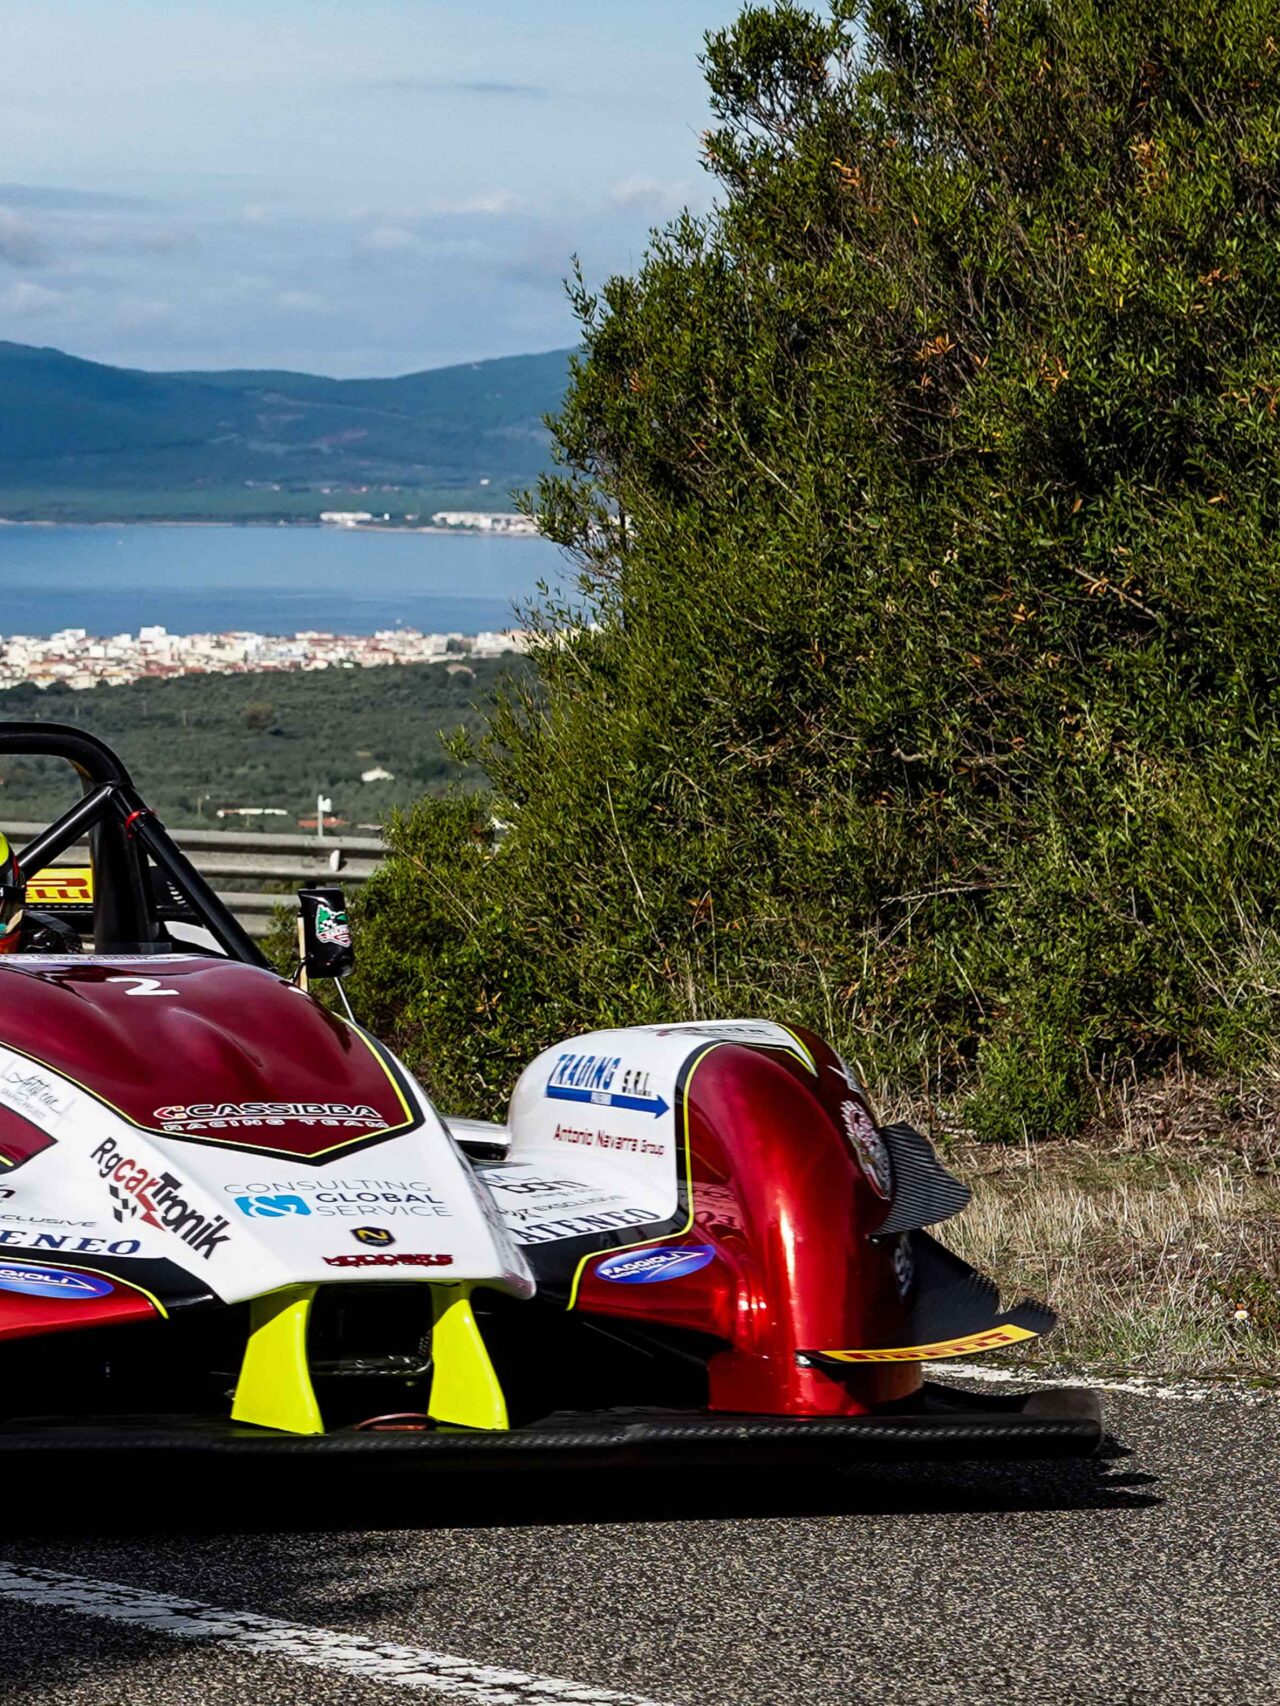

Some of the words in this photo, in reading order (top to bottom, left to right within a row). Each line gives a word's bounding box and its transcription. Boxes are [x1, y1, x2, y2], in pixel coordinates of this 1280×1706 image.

[106, 977, 180, 995] 2
[553, 1054, 622, 1090] TRADING
[188, 1103, 382, 1118] CASSIBBA
[163, 1120, 283, 1131] RACING
[298, 1119, 389, 1130] TEAM
[553, 1124, 593, 1145] Antonio
[596, 1129, 637, 1151] Navarra
[223, 1179, 433, 1195] CONSULTING
[315, 1192, 445, 1204] GLOBAL
[315, 1203, 454, 1217] SERVICE
[506, 1208, 661, 1243] ATENEO
